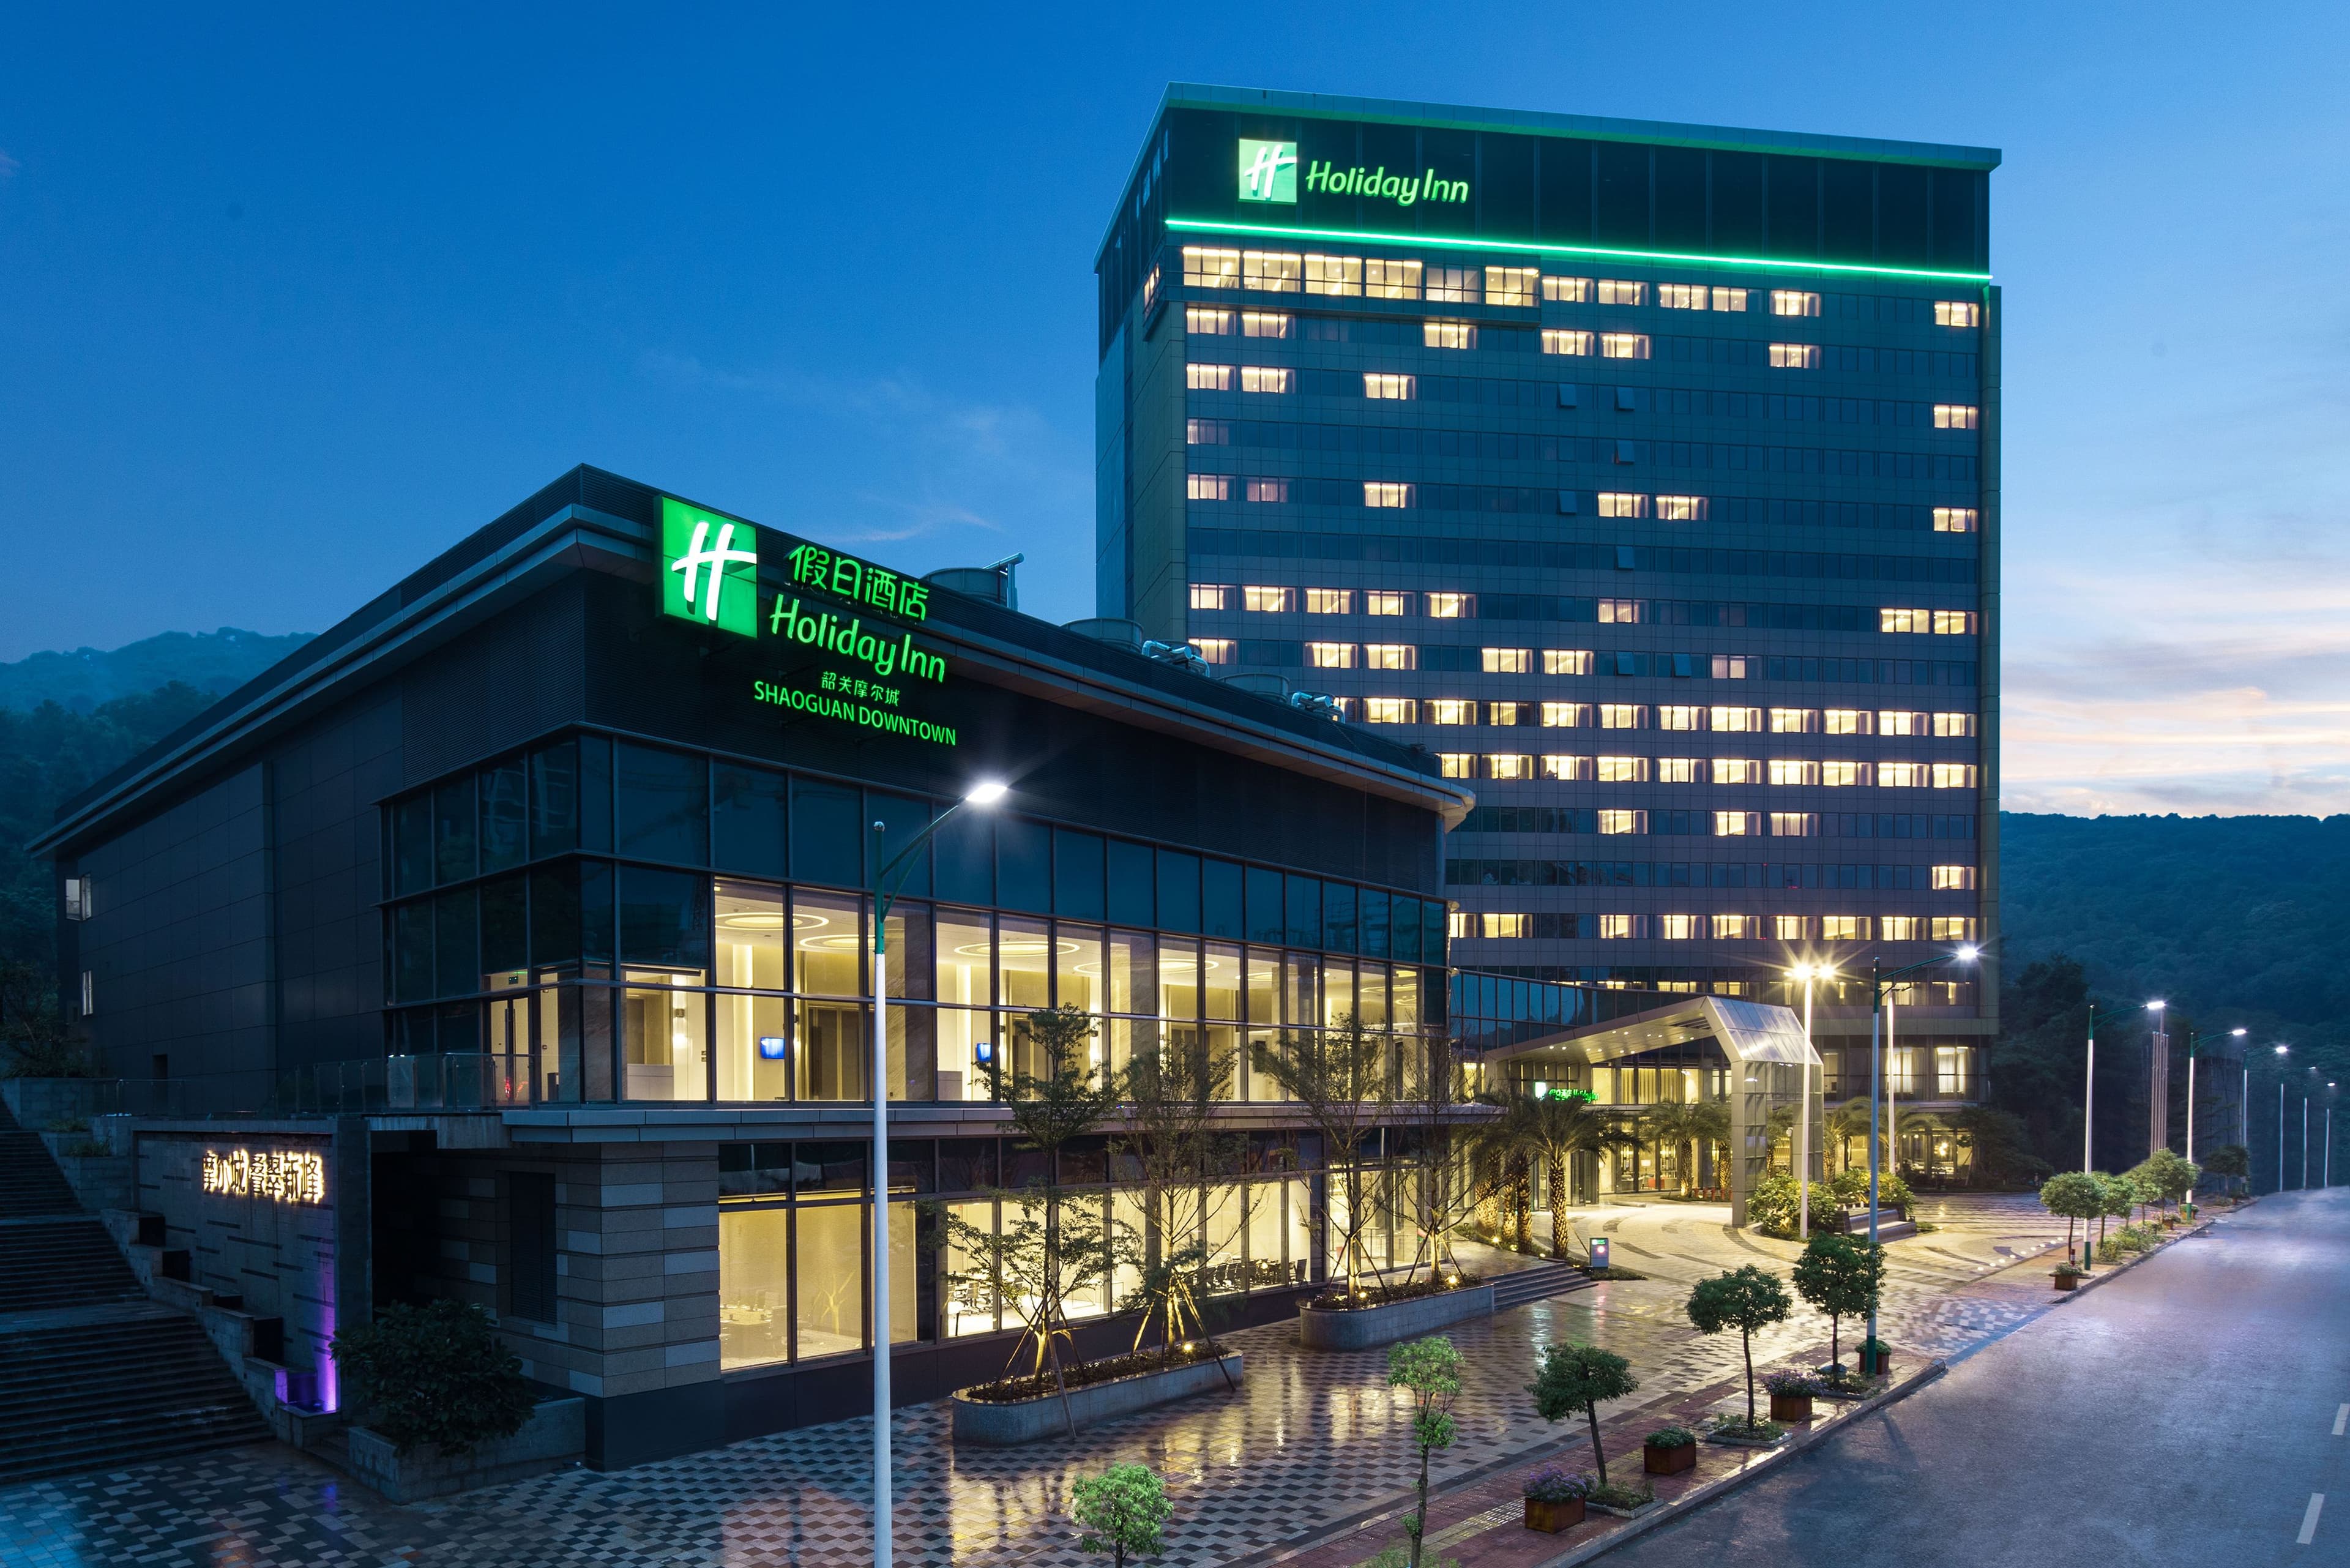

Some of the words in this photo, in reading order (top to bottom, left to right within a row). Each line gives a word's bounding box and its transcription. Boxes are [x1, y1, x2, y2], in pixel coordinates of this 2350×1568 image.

[1305, 160, 1420, 206] Holiday
[1422, 168, 1469, 203] Inn
[788, 544, 930, 621] 假日酒店
[769, 593, 897, 676] Holiday
[900, 633, 946, 683] Inn
[753, 680, 855, 722] SHAOGUAN
[858, 705, 957, 746] DOWNTOWN
[821, 670, 901, 707] 韶关摩尔城
[203, 1152, 246, 1193] 摩尔城
